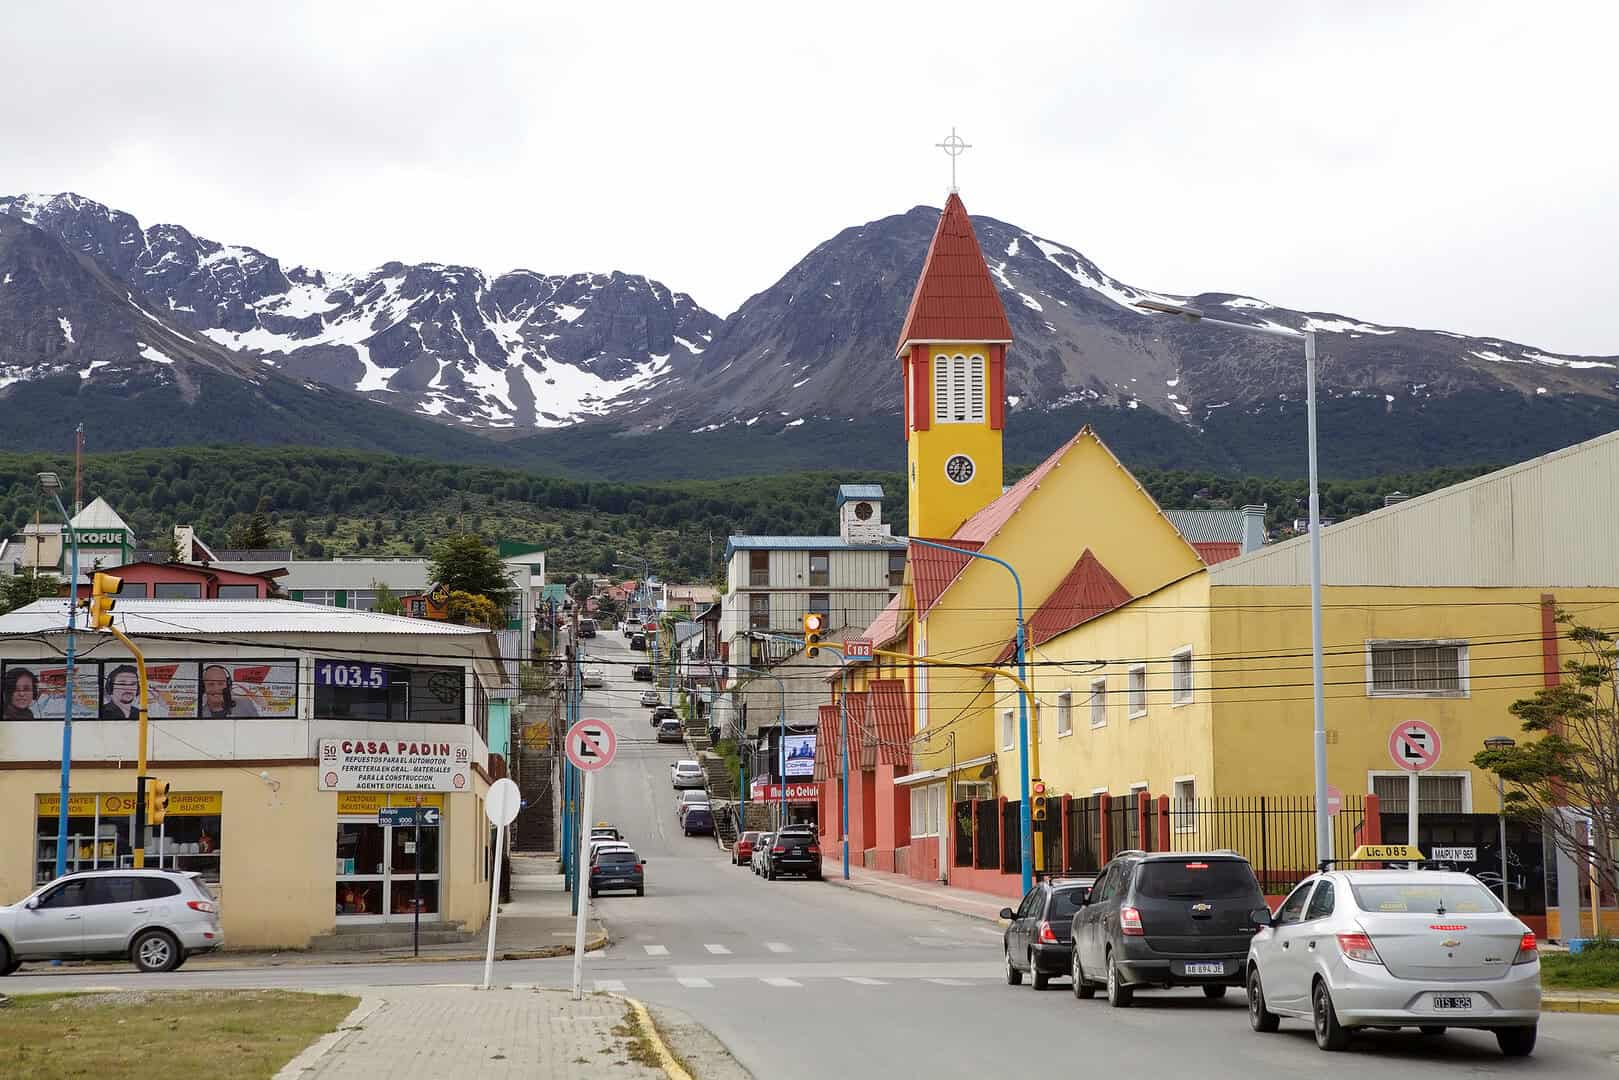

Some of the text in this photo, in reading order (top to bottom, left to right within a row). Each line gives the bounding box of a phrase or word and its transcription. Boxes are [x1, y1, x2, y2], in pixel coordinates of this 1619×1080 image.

[321, 664, 383, 688] 103.5
[324, 745, 337, 755] 50
[341, 741, 450, 756] CASA PADIN
[456, 748, 467, 758] 50
[771, 786, 795, 797] Mudo
[1366, 847, 1408, 857] Lic. 085
